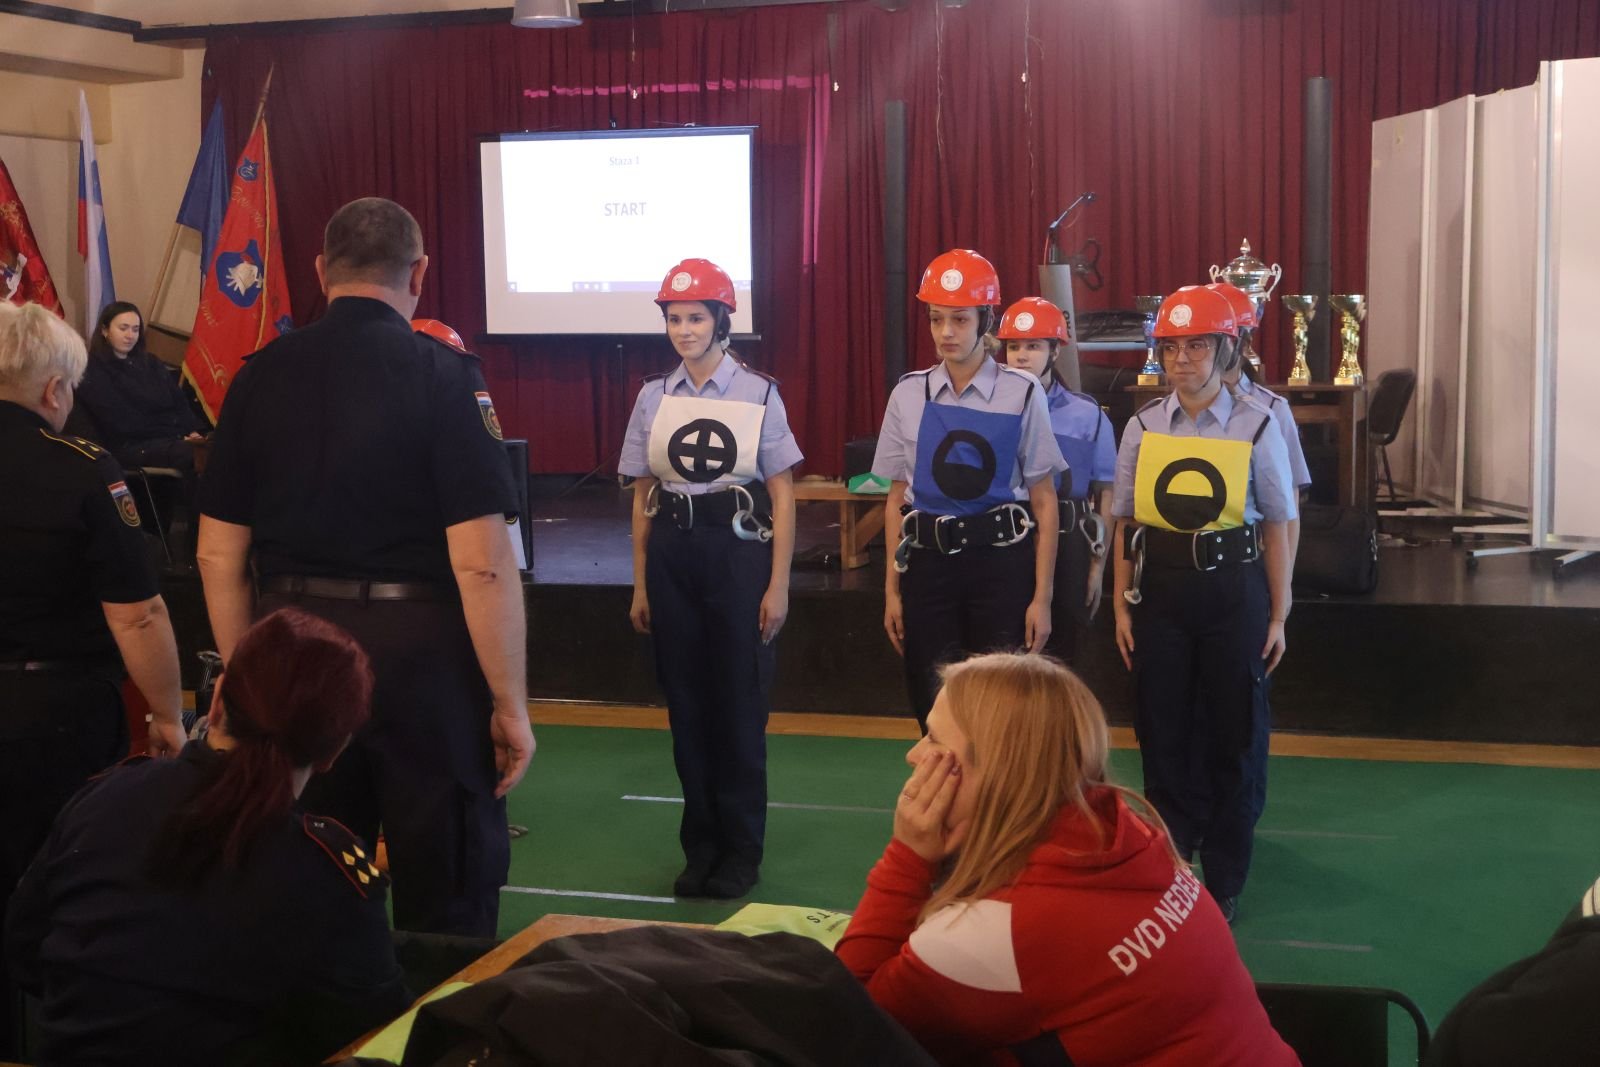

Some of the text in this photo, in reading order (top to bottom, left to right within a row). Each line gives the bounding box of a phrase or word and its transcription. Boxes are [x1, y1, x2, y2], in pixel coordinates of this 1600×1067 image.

[609, 156, 632, 166] Staza
[604, 202, 647, 217] START
[1107, 918, 1166, 976] DVD
